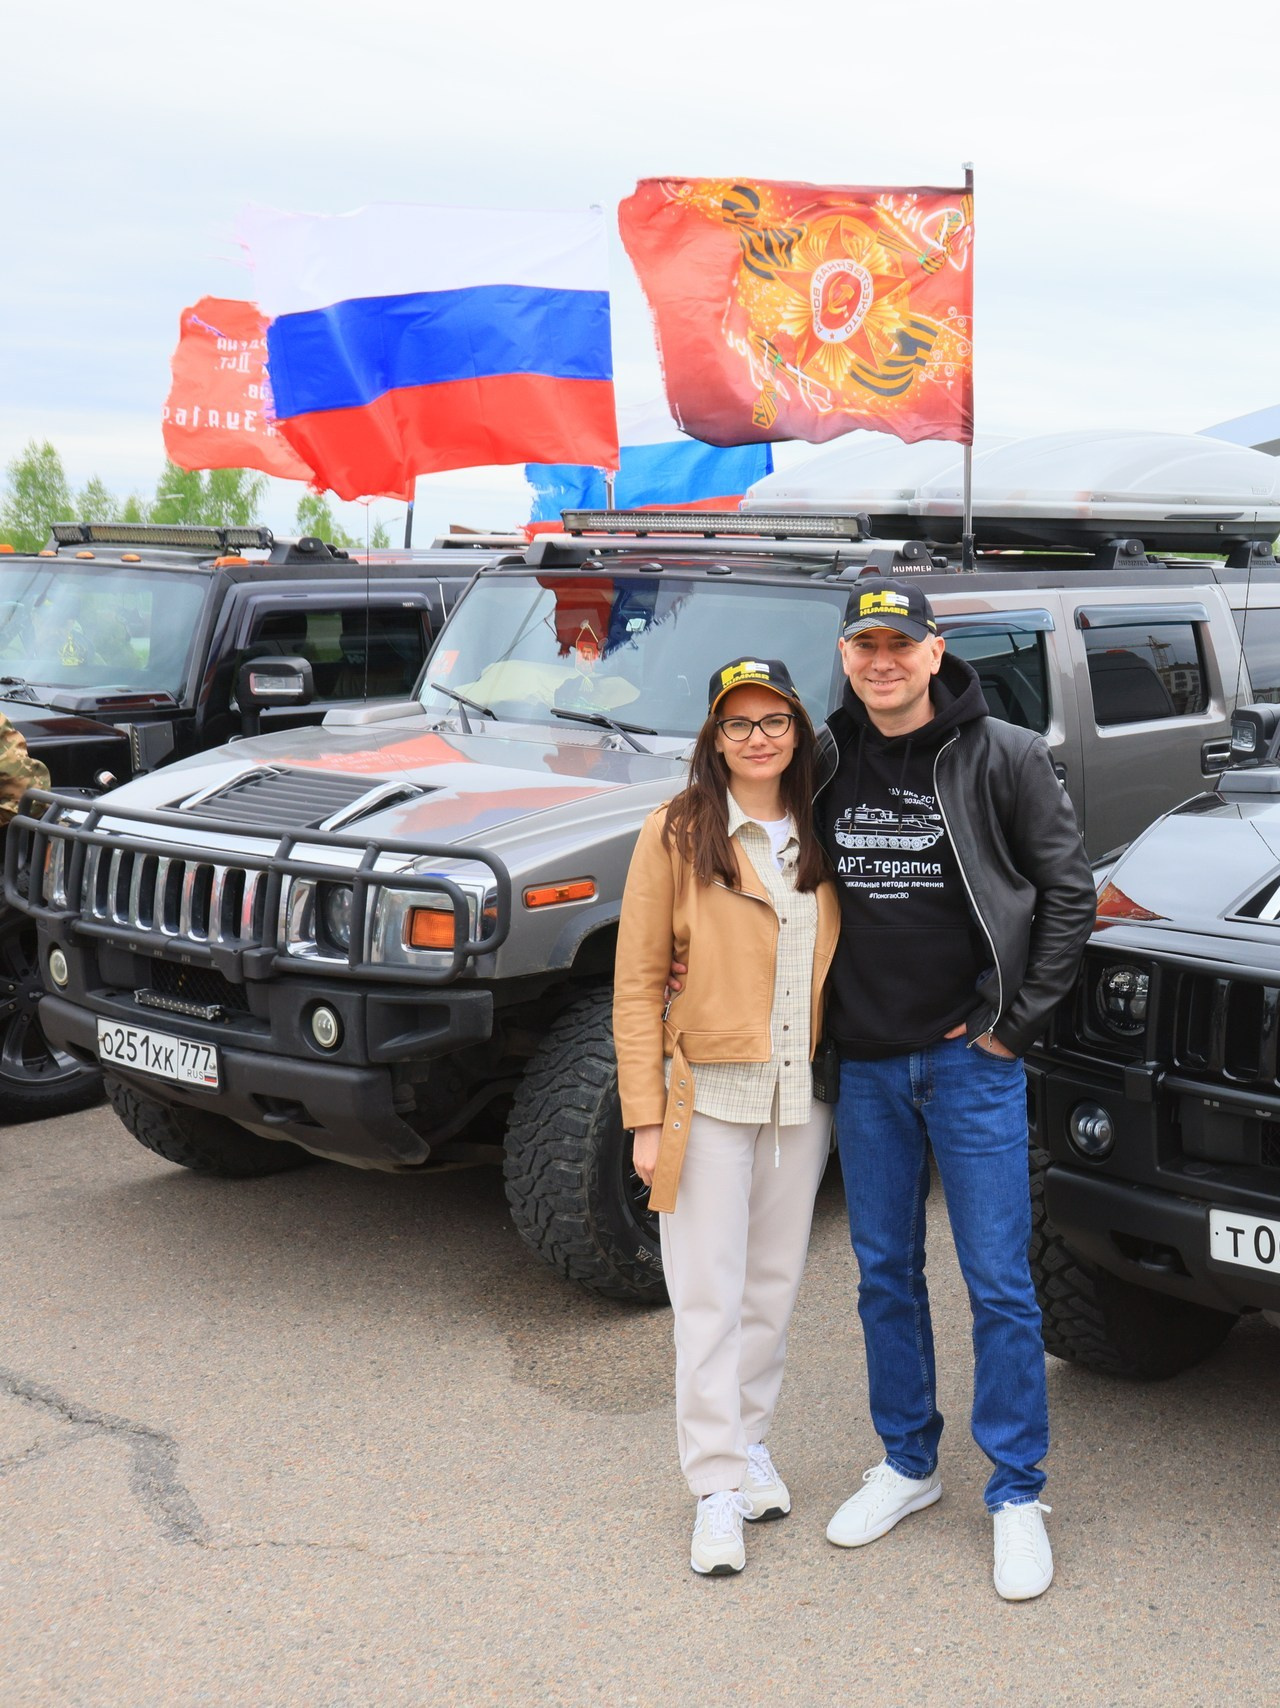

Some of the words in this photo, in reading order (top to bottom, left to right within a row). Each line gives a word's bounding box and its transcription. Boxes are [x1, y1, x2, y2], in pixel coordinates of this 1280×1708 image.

[860, 606, 909, 617] HUMMER
[837, 856, 942, 878] АРТ-терапия
[881, 881, 909, 889] методы
[911, 881, 944, 889] лечения
[869, 892, 909, 900] #ПомогаюСВО
[180, 1042, 211, 1071] 777
[187, 1069, 204, 1080] RUS
